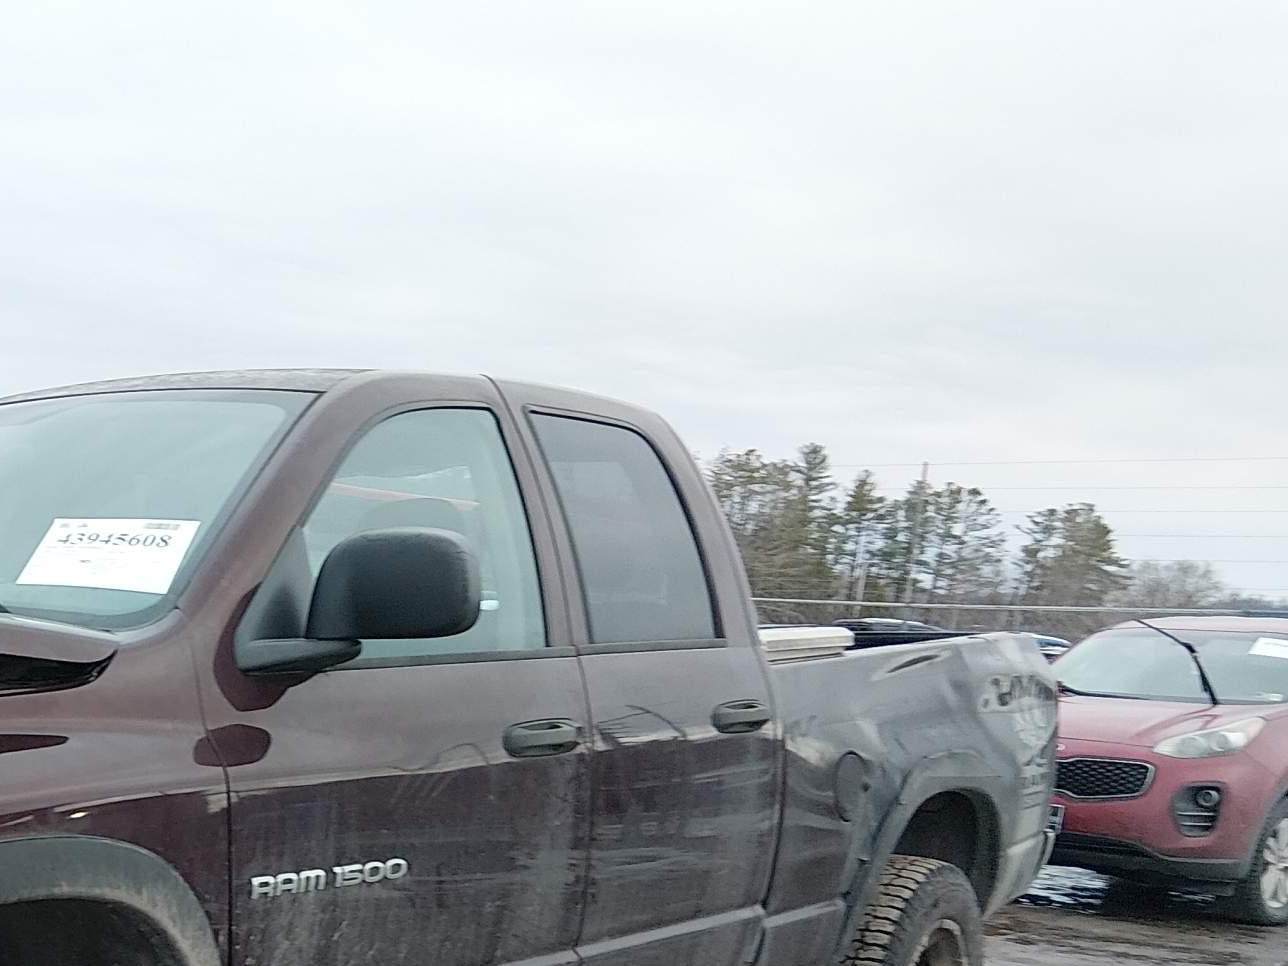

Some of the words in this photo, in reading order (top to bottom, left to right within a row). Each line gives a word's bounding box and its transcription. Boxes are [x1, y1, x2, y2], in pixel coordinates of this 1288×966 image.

[57, 533, 172, 548] 43945608
[250, 868, 327, 900] RAM
[332, 857, 409, 888] 1500
